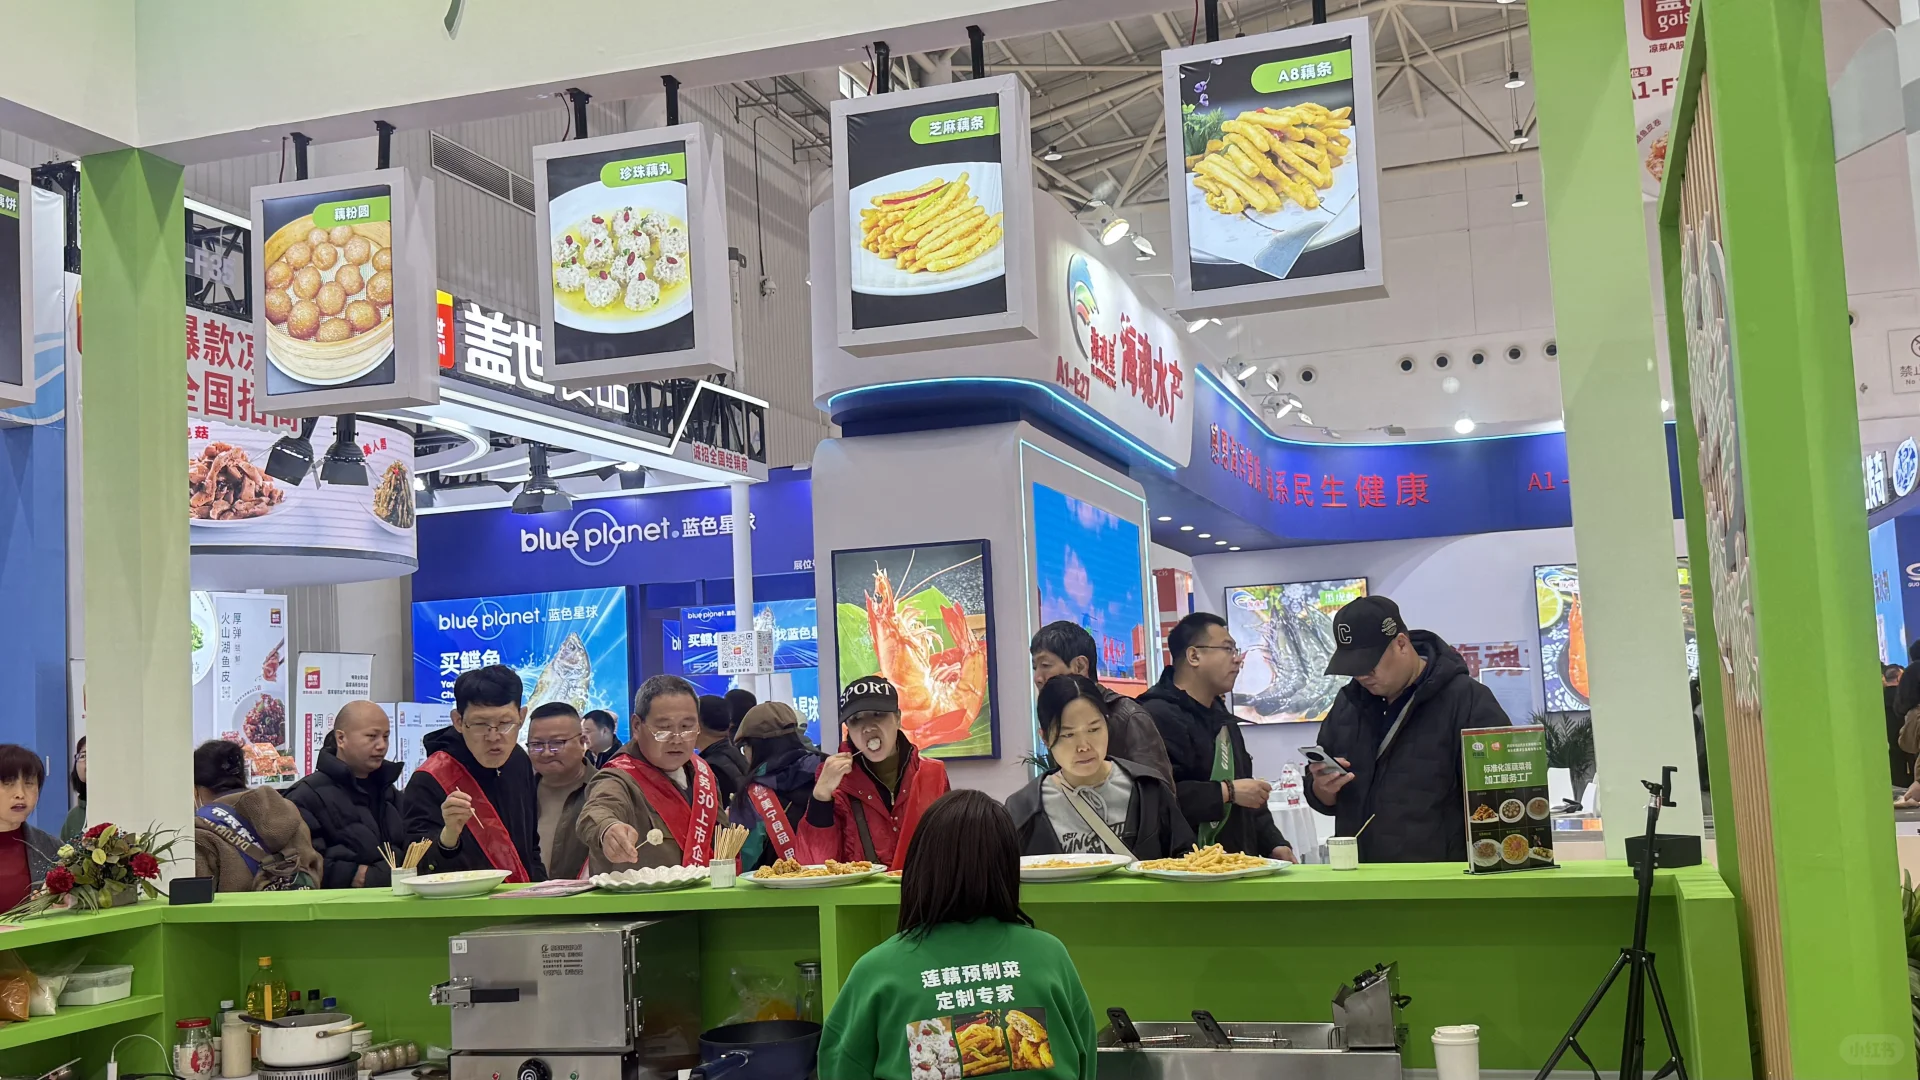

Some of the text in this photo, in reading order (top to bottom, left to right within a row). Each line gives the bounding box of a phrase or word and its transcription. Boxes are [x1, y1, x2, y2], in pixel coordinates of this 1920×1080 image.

[1277, 60, 1333, 83] A8藕条
[1632, 77, 1679, 100] 1-F
[928, 116, 985, 137] 芝麻藕条
[619, 162, 672, 181] 珍珠藕丸
[333, 204, 370, 221] 藕粉圆
[1056, 356, 1090, 403] A1-E27
[1120, 312, 1183, 424] 海魂水产
[187, 425, 209, 440] 菇
[693, 442, 749, 473] 诚招全国经销商
[520, 528, 579, 553] blue
[438, 613, 478, 631] blue
[548, 604, 598, 622] 蓝色星球
[687, 612, 703, 620] blue
[688, 633, 718, 648] 买鲽
[1337, 624, 1352, 644] C
[221, 612, 230, 683] 火山湖鱼皮
[840, 681, 893, 708] SPORT
[1484, 771, 1533, 785] 加工服务工厂
[921, 960, 1021, 989] 莲藕预制菜
[935, 984, 1015, 1012] 定制专家
